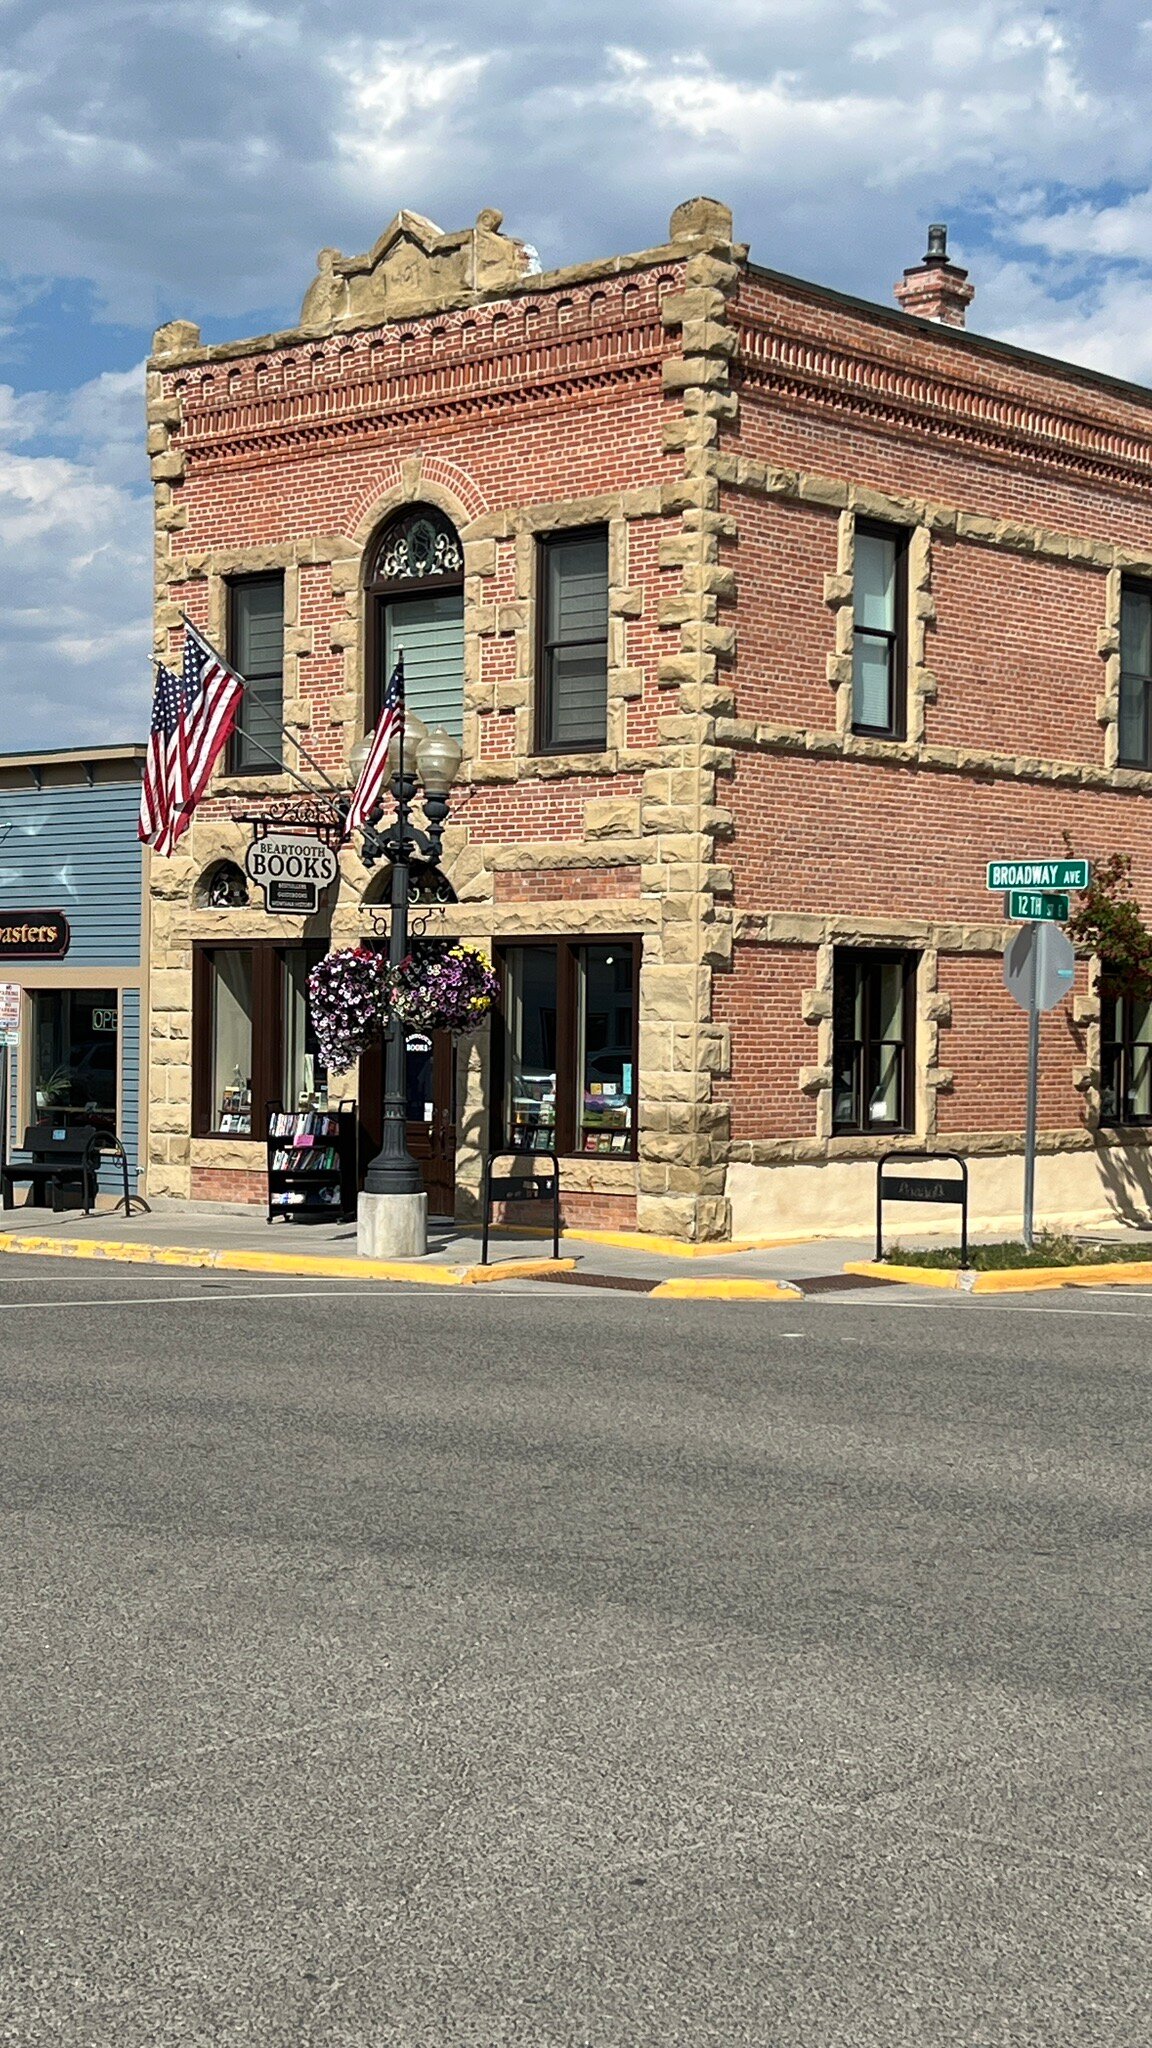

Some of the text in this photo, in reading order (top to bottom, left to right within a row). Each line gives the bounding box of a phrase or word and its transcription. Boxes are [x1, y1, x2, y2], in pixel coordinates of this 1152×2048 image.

[260, 842, 326, 857] BEARTOOTH
[253, 854, 332, 879] BOOKS
[992, 865, 1081, 886] BROADWAY AVE
[0, 923, 58, 943] asters
